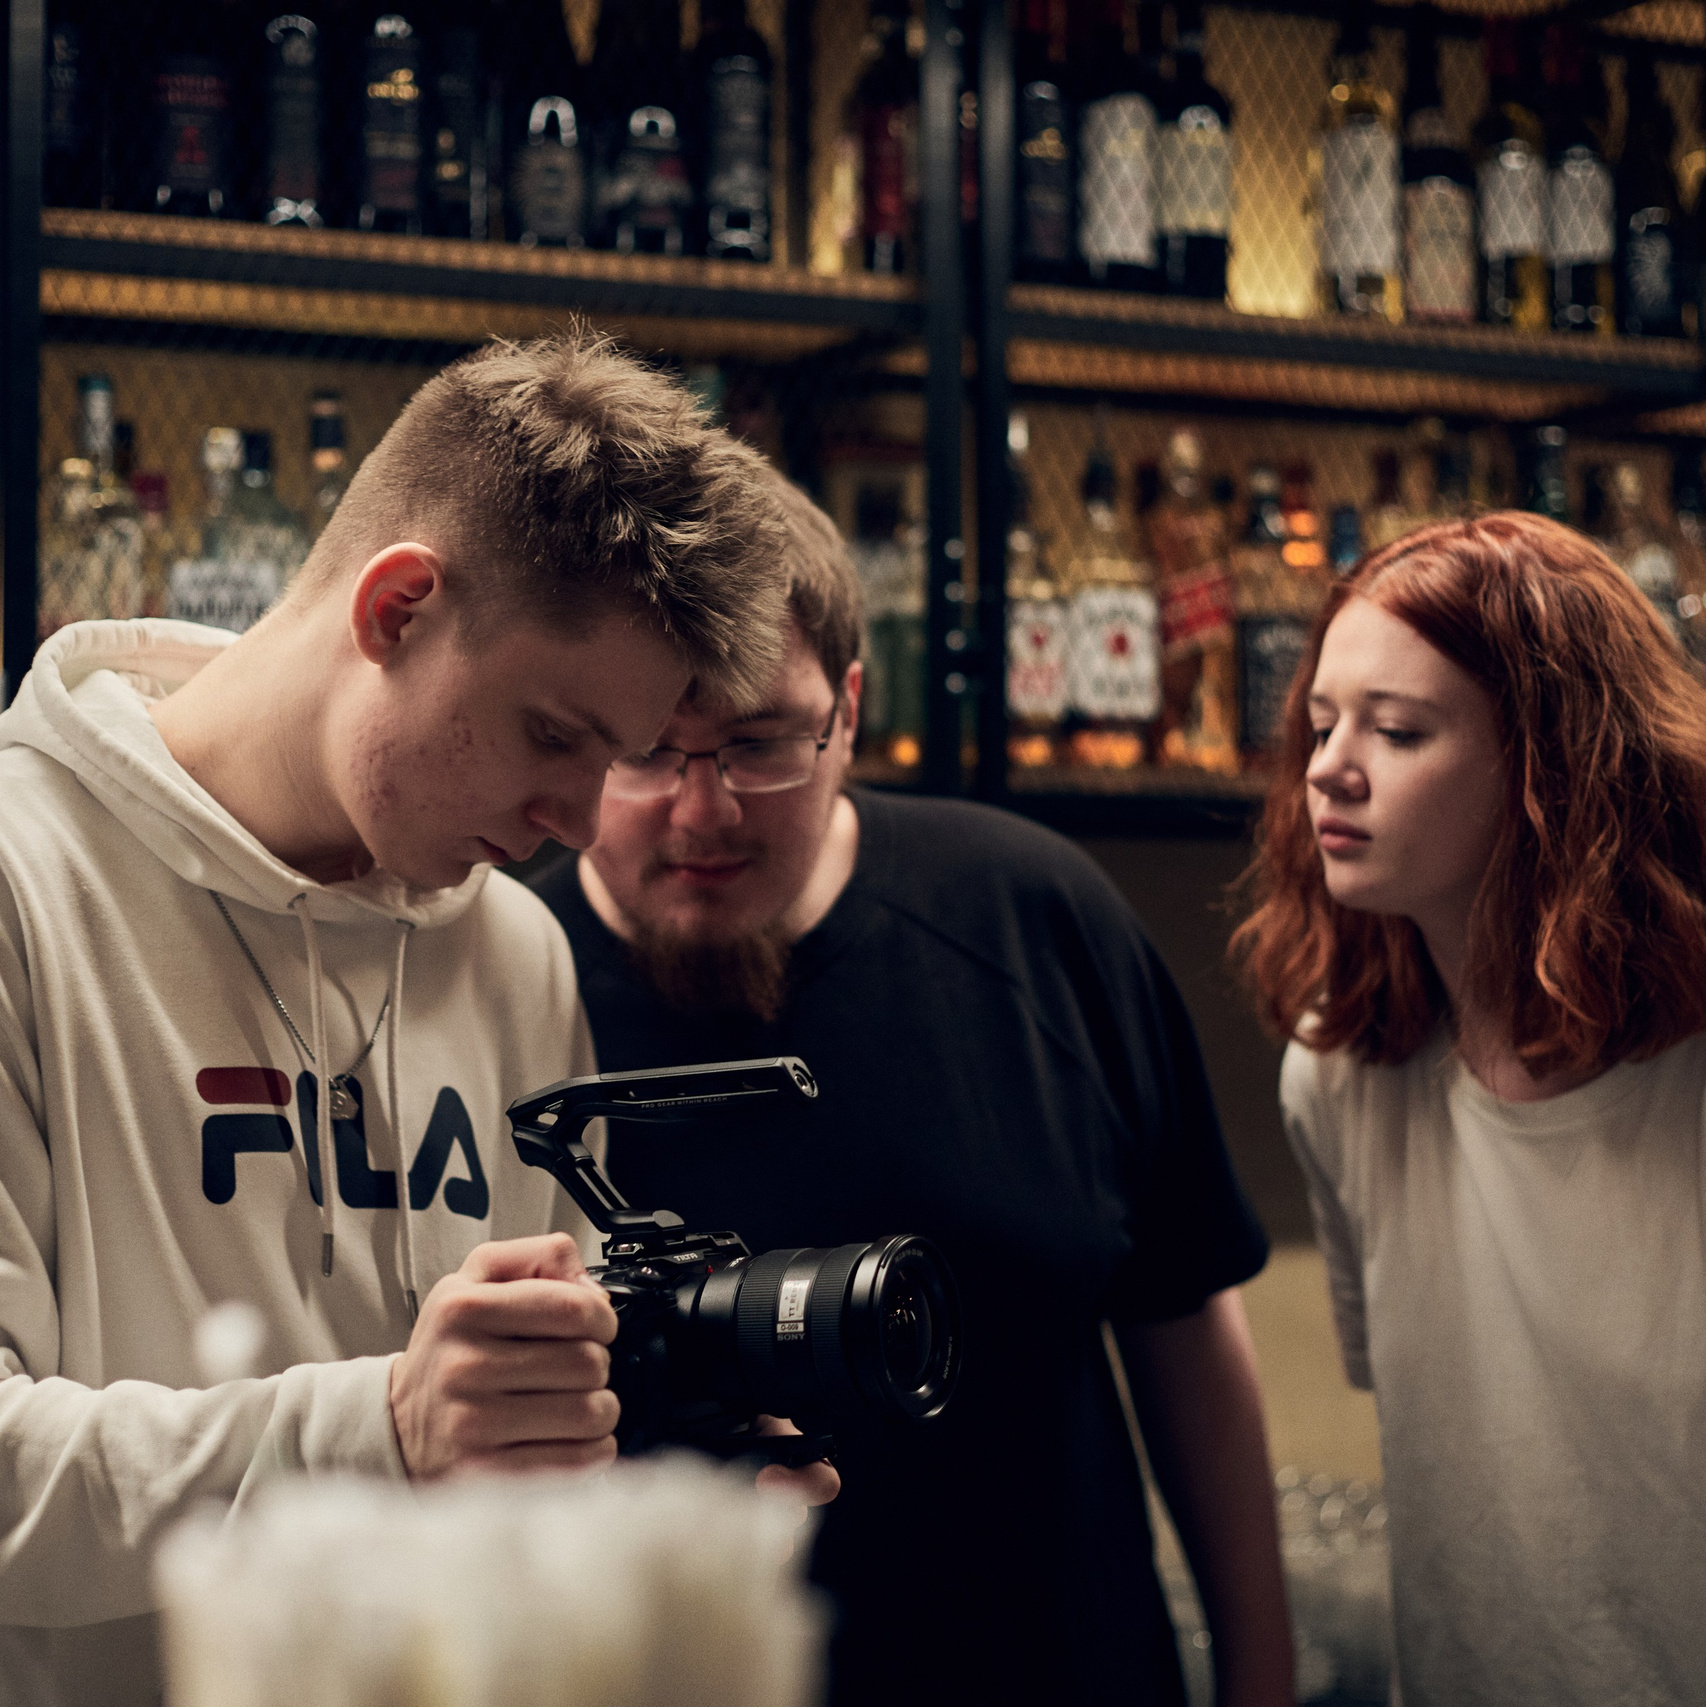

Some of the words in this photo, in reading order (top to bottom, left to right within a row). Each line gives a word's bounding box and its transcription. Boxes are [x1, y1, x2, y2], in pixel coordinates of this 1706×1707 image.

[196, 1067, 490, 1221] FILA
[673, 1252, 699, 1262] TILTA
[777, 1333, 805, 1342] SONY
